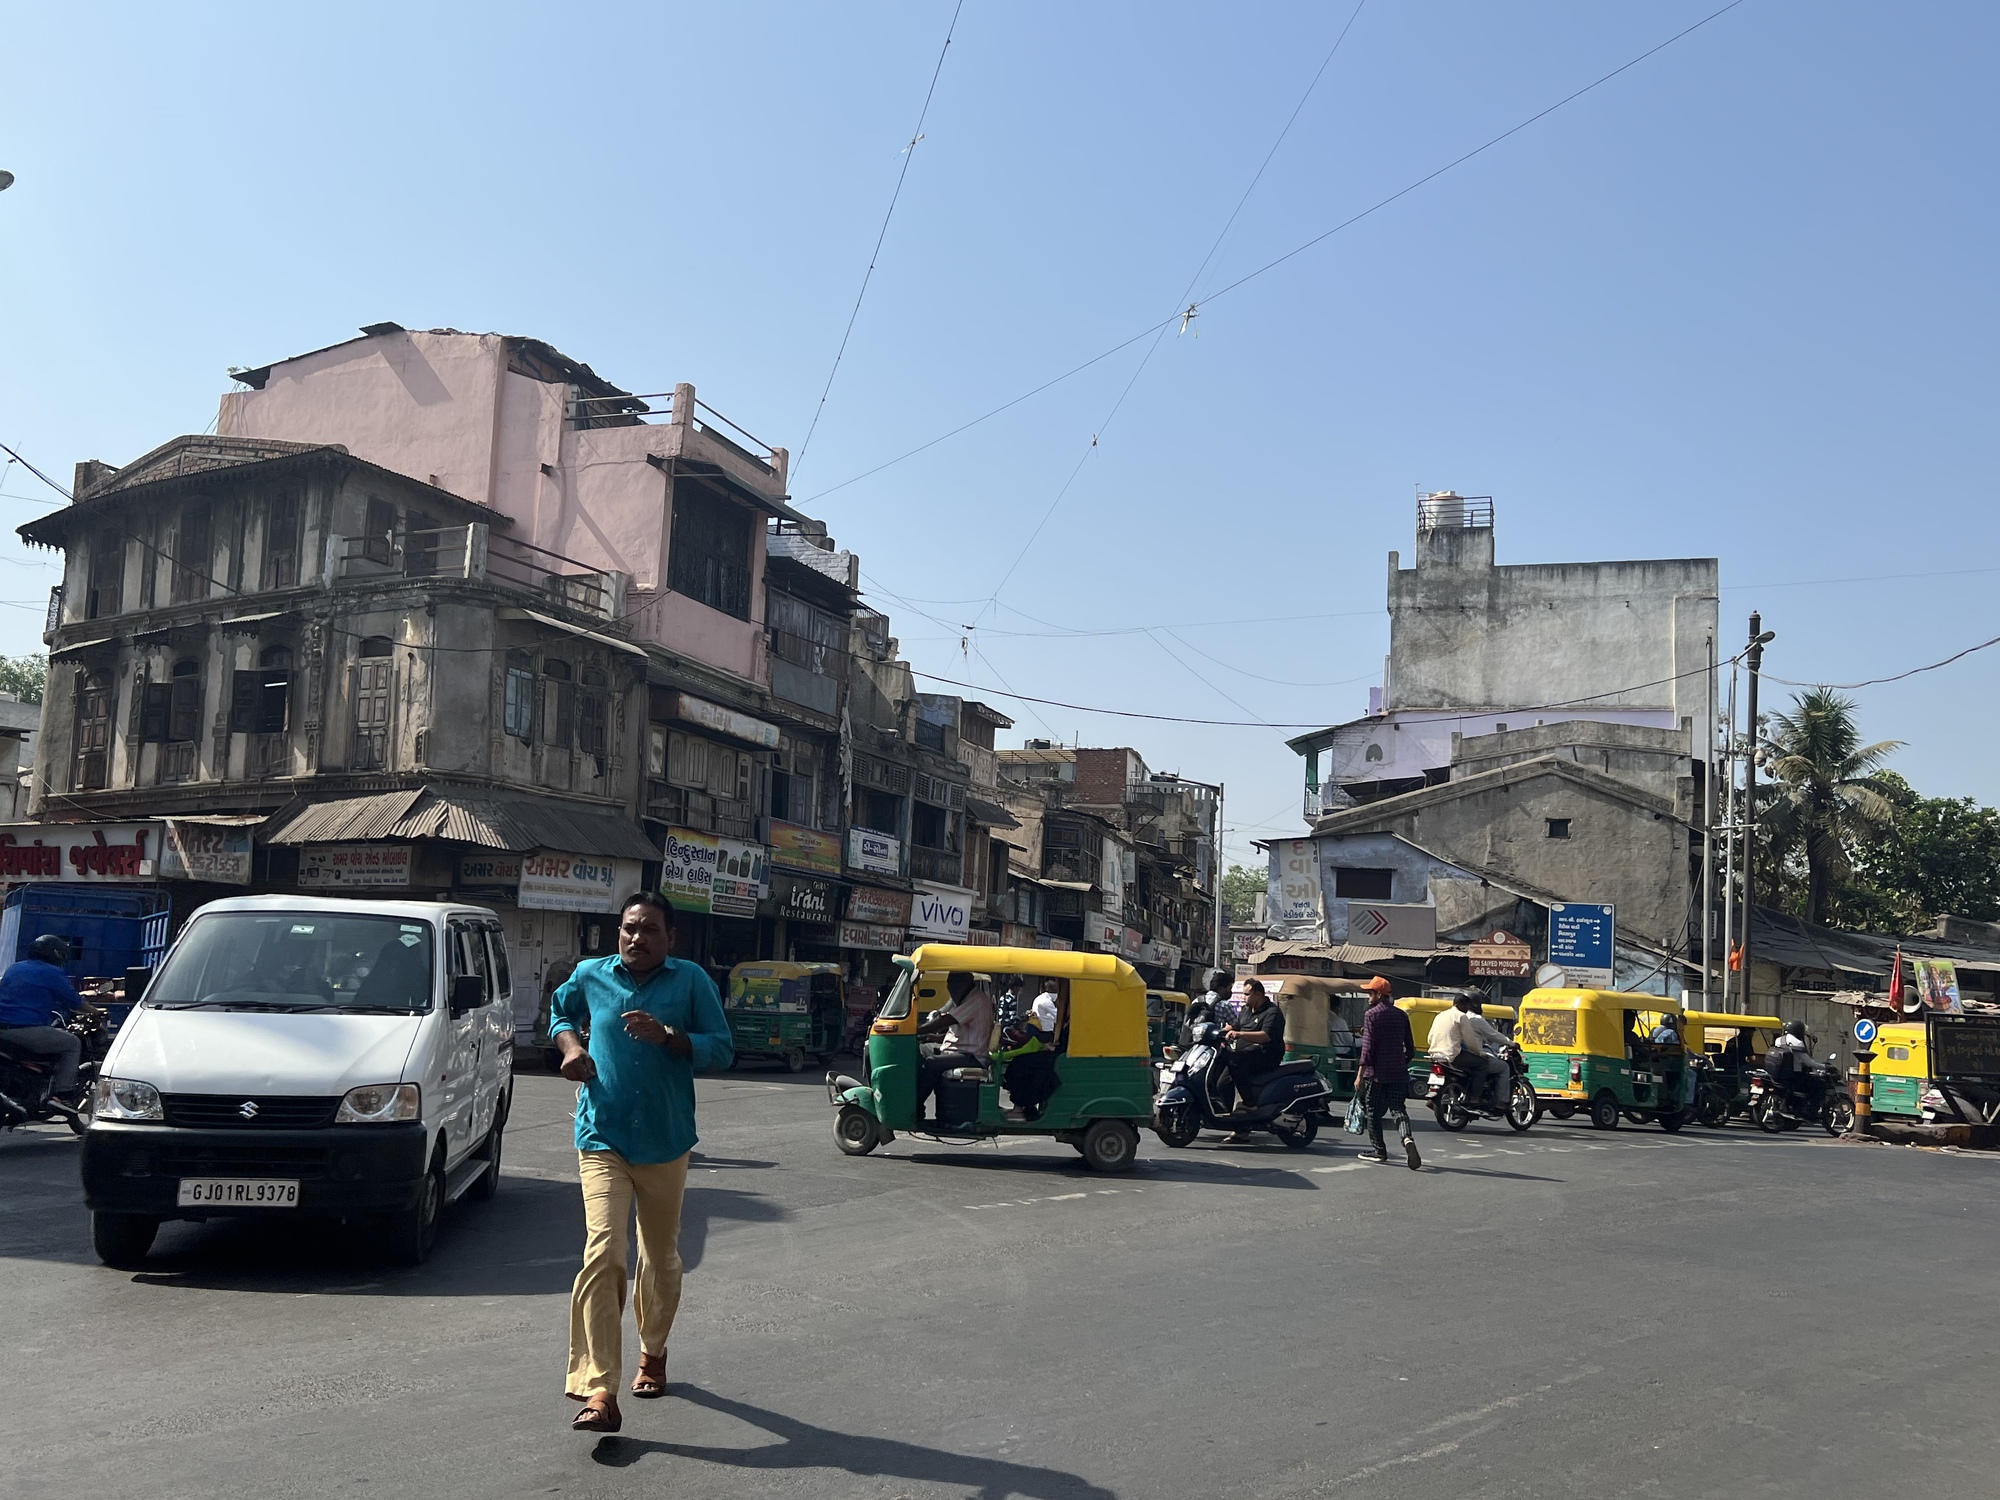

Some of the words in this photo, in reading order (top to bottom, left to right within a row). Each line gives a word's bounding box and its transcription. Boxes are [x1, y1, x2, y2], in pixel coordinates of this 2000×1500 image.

[333, 851, 348, 866] અમર
[350, 847, 363, 866] વોચ
[665, 836, 717, 866] હિન્દુસ્તાન
[463, 862, 494, 878] અમર
[494, 861, 512, 877] વોચ
[524, 855, 571, 879] અમર
[572, 858, 598, 881] વોચ
[665, 860, 684, 880] બેગ
[687, 866, 713, 885] હાઉસ
[780, 905, 831, 922] Restaurant
[921, 896, 963, 926] vivo
[1498, 960, 1520, 968] MOSQUE
[193, 1184, 296, 1202] GJ01RL9378
